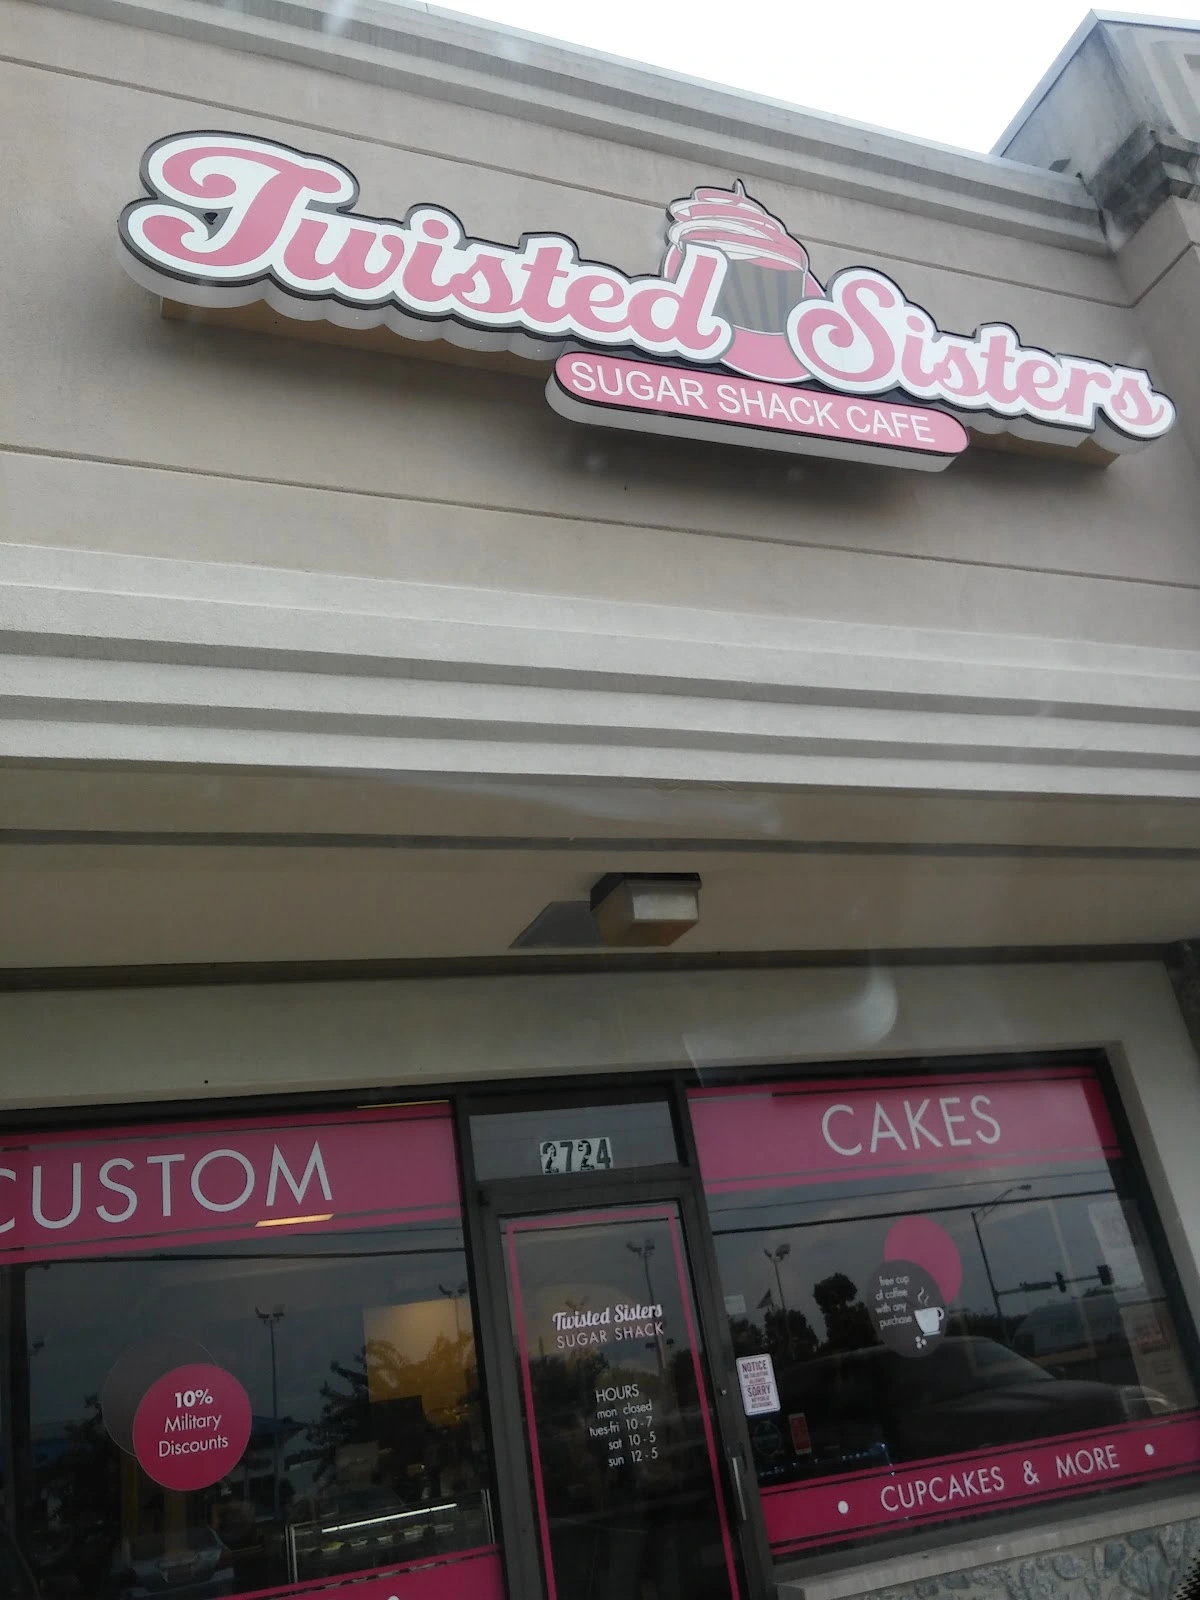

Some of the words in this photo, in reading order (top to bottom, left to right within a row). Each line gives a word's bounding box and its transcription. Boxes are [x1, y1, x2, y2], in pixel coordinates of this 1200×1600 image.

[136, 141, 732, 354] Twisted
[792, 275, 1169, 430] Sisters
[572, 360, 706, 410] SUGAR
[718, 382, 841, 431] SHACK
[846, 404, 935, 445] CAFE
[822, 1095, 1001, 1156] CAKES
[542, 1138, 611, 1174] 2724
[552, 1307, 611, 1331] Twisted
[614, 1304, 663, 1323] Sisters
[557, 1330, 607, 1349] SUGAR
[614, 1321, 665, 1341] SHACK
[742, 1360, 768, 1372] NOTICE
[174, 1388, 214, 1409] 10%
[595, 1383, 640, 1403] HOURS
[747, 1385, 770, 1397] SORRY
[597, 1408, 618, 1420] mon
[622, 1398, 653, 1415] closed
[164, 1412, 222, 1434] Military
[589, 1420, 621, 1438] tues-fri
[158, 1434, 229, 1458] Discounts
[608, 1438, 623, 1451] sat
[608, 1456, 625, 1468] sun
[880, 1465, 1005, 1512] CUPCAKES
[1022, 1459, 1041, 1486] &
[1055, 1444, 1120, 1479] MORE
